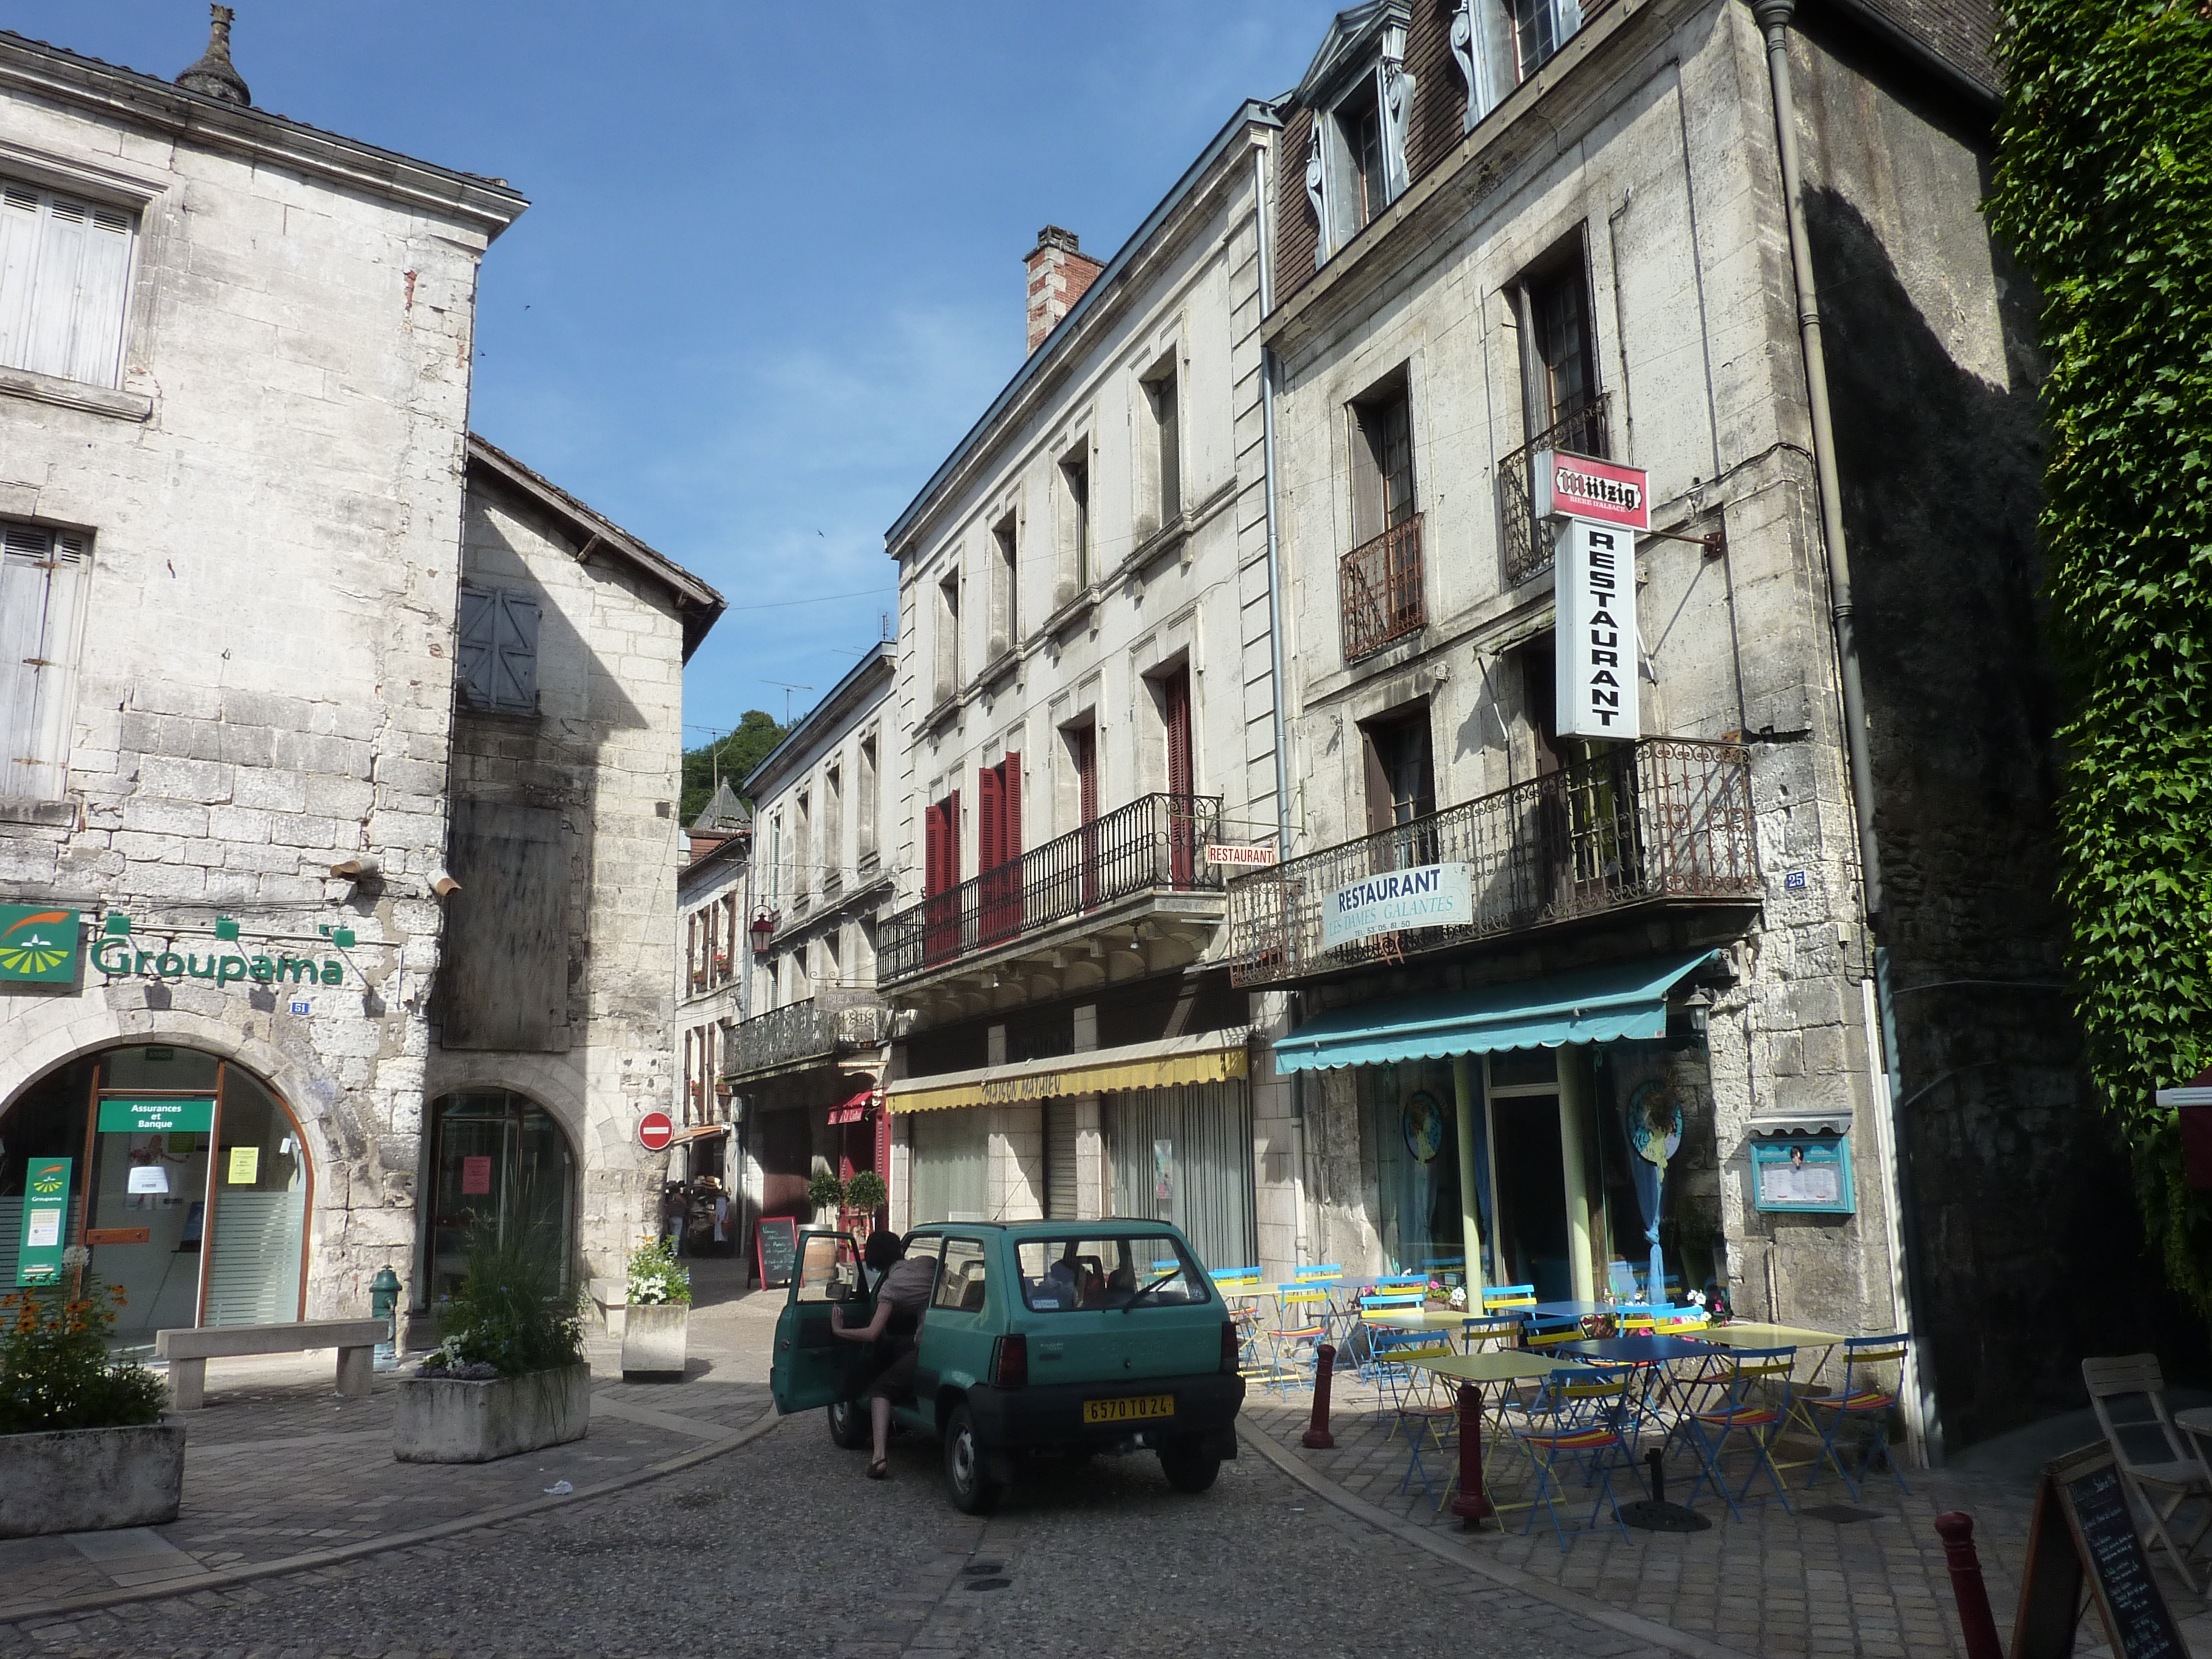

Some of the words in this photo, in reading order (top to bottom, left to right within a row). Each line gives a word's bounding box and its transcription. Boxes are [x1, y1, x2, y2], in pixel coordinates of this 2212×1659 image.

[1594, 502, 1626, 512] D'ALSACE
[1589, 531, 1620, 726] RESTAURANT
[1210, 848, 1272, 863] RESTAURANT
[1789, 873, 1803, 886] 25
[1338, 869, 1440, 913] RESTAURANT
[1329, 918, 1342, 936] LES
[1344, 908, 1376, 930] DAMES
[1384, 896, 1453, 919] GALANTES
[91, 937, 343, 988] Groupama
[295, 1004, 306, 1012] 51
[984, 1081, 1017, 1104] MAISON
[1022, 1073, 1061, 1100] MATHIEU
[138, 1120, 172, 1128] Banque
[1091, 1401, 1125, 1419] 6570
[1151, 1398, 1166, 1413] 24
